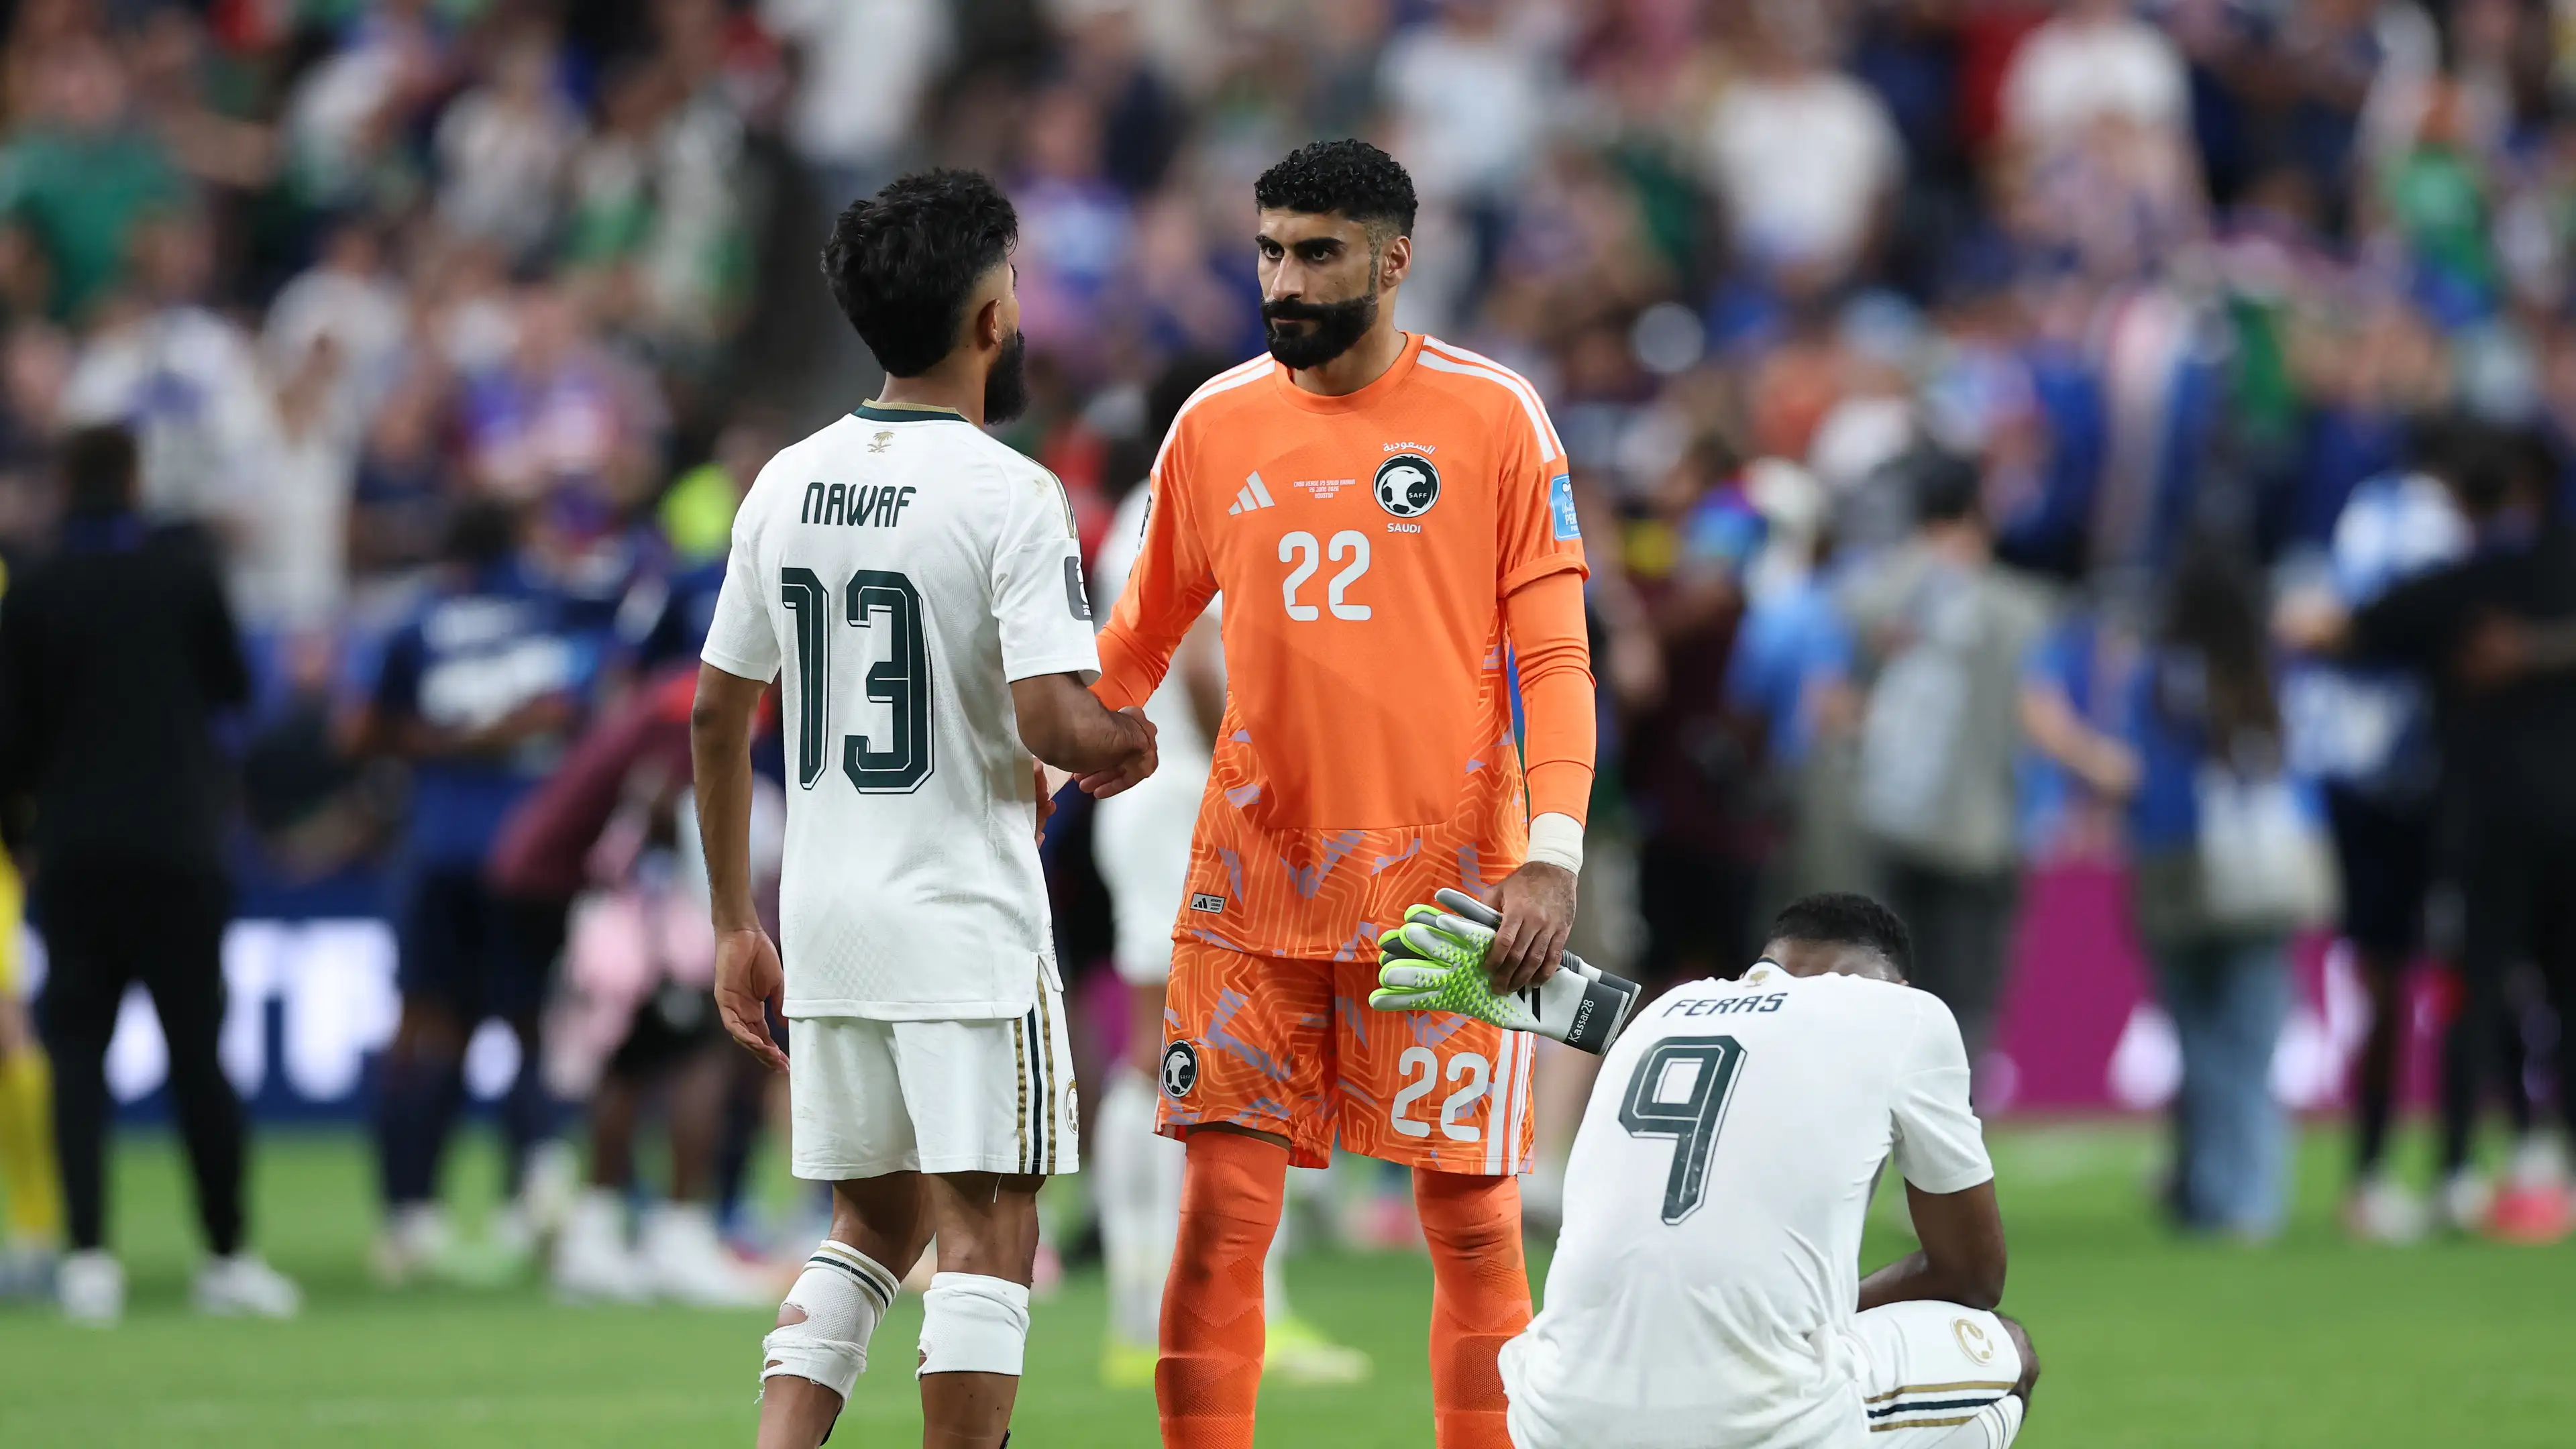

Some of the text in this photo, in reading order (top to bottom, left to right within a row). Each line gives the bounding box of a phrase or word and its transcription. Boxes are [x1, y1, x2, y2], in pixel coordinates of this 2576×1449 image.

[1383, 441, 1436, 455] السعودية
[801, 482, 916, 527] NAWAF
[1387, 523, 1421, 534] SAUDI
[1278, 530, 1372, 622] 22
[782, 567, 934, 795] 13
[1568, 999, 1595, 1043] Kassar28
[1661, 991, 1788, 1018] FERAS
[1391, 1046, 1491, 1142] 22
[1617, 1034, 1748, 1226] 9
